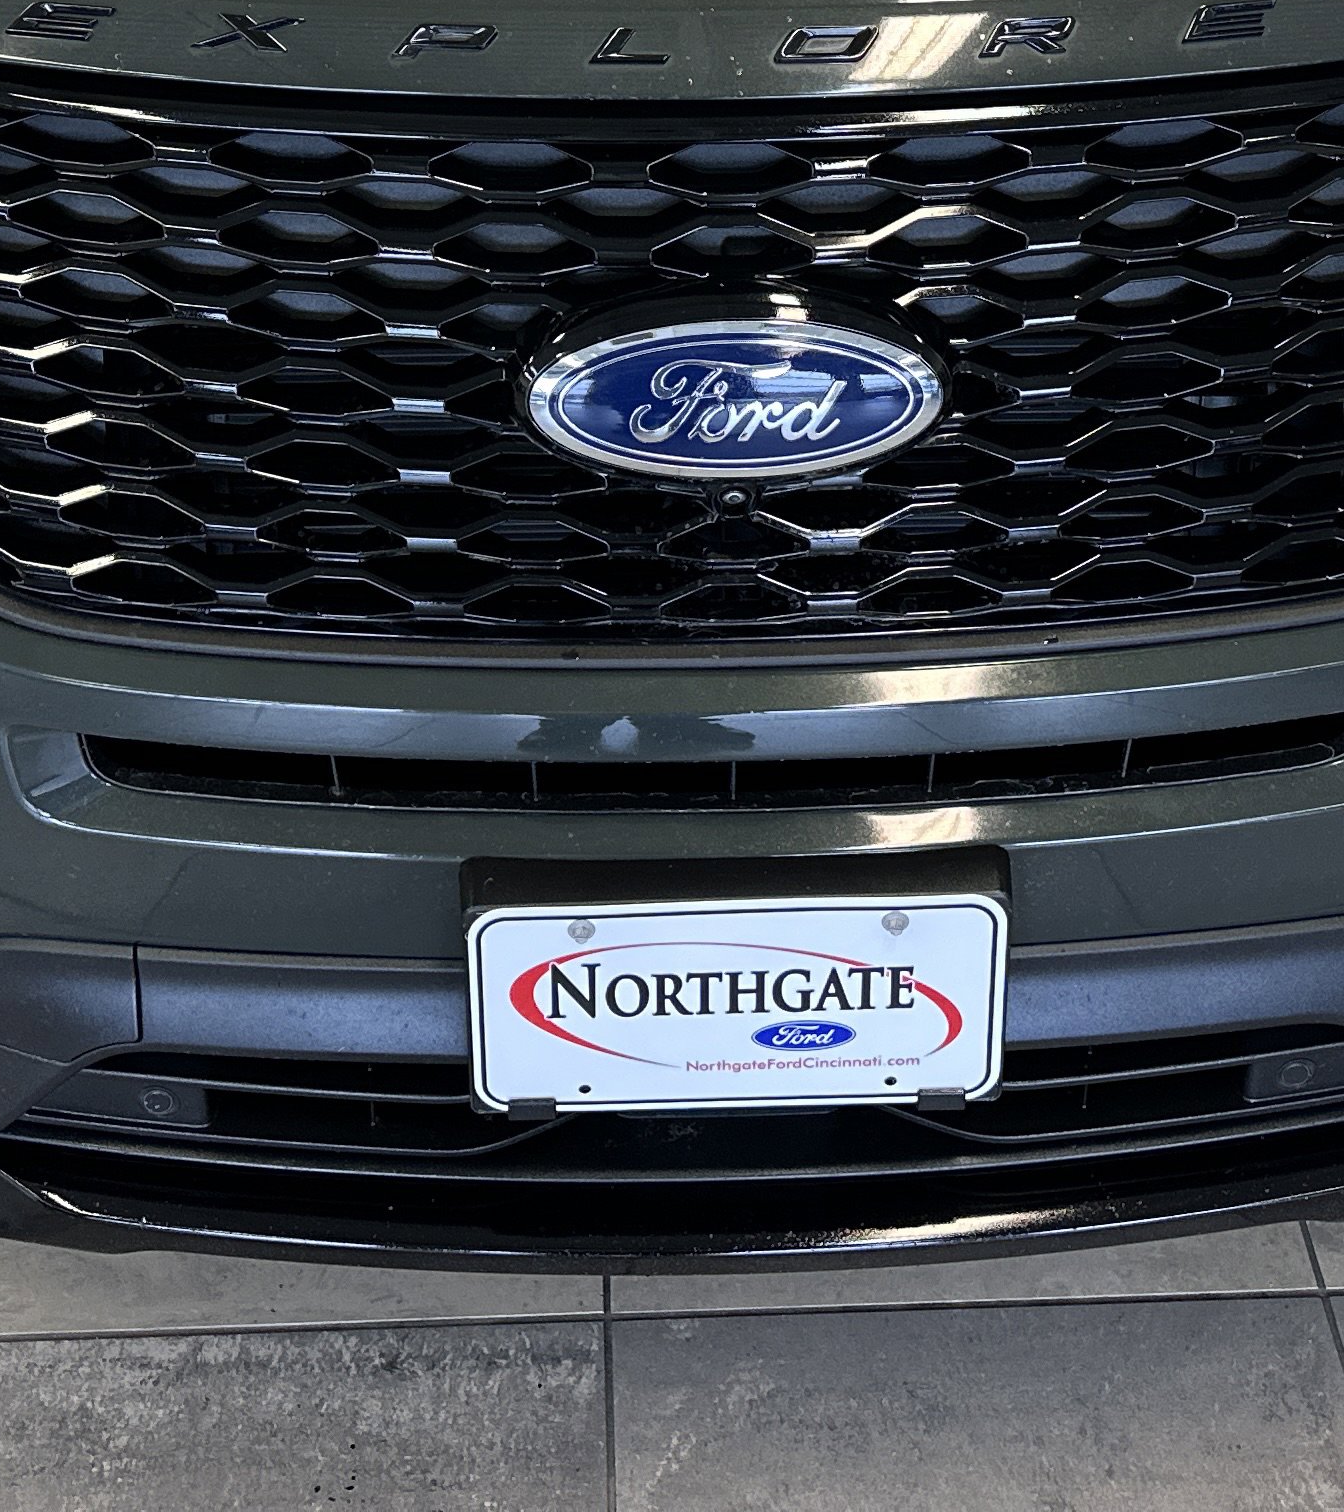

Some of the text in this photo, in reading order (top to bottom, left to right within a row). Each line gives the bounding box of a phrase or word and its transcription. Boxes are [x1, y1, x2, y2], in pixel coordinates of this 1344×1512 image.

[629, 358, 848, 443] Ford
[546, 962, 915, 1020] NORTHGATE
[771, 1024, 836, 1046] Ford
[686, 1054, 921, 1074] NorthgateFordCincinnati.com
